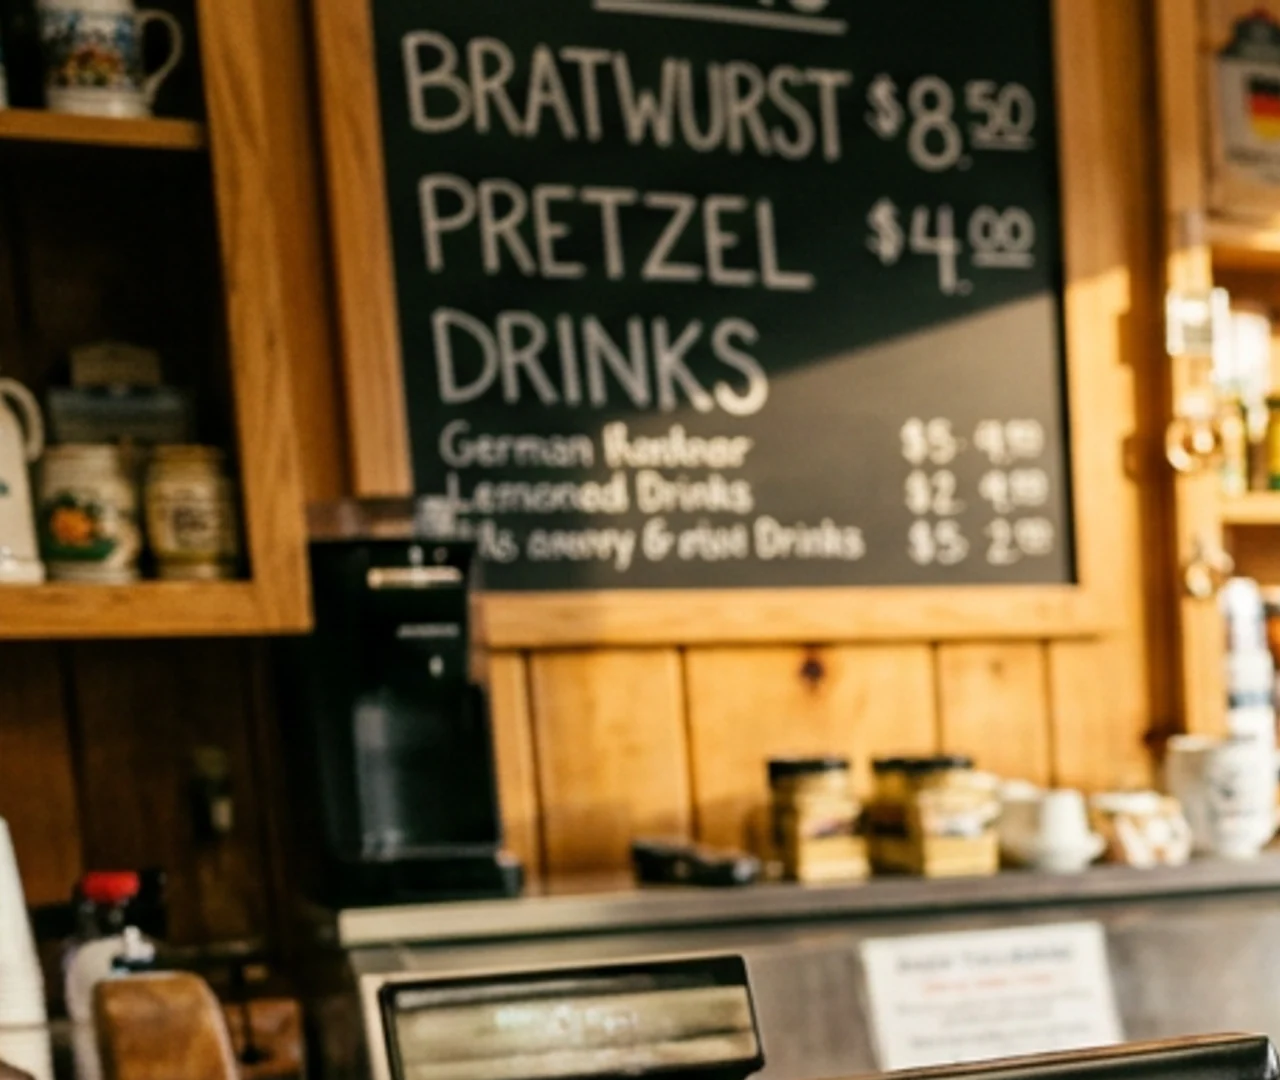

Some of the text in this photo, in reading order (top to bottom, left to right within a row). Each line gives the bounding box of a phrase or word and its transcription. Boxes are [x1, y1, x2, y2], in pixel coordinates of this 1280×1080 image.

[402, 31, 851, 162] BRATWURST
[418, 174, 816, 292] PRETZEL
[431, 308, 769, 416] DRINKS
[634, 468, 755, 514] Drinks
